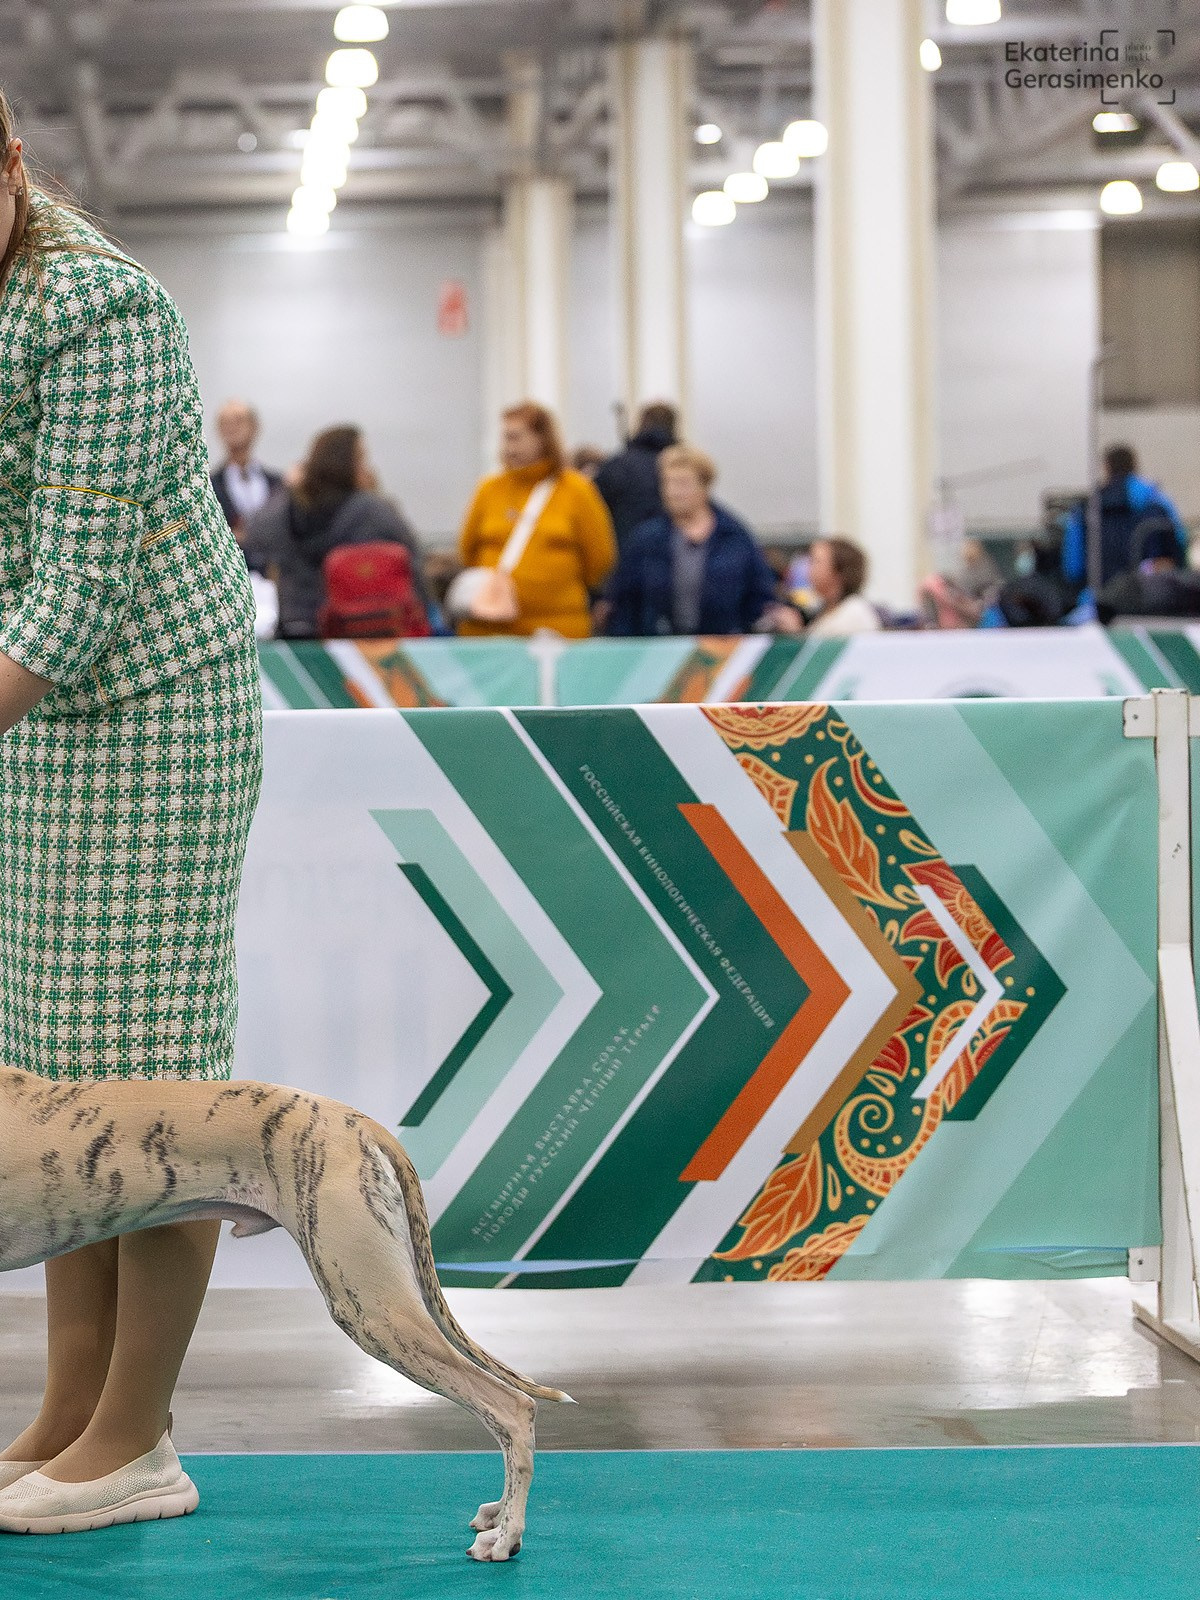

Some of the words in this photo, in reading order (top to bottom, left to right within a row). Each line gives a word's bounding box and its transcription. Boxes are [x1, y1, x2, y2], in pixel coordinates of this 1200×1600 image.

[578, 763, 643, 848] РОССИЙСКАЯ
[637, 841, 723, 958] КИНОЛОГИЧЕСКАЯ
[718, 952, 776, 1029] ФЕДЕРАЦИЯ
[471, 1152, 537, 1236] ВСЕМИРНАЯ
[534, 1075, 594, 1152] ВЫСТАВКА
